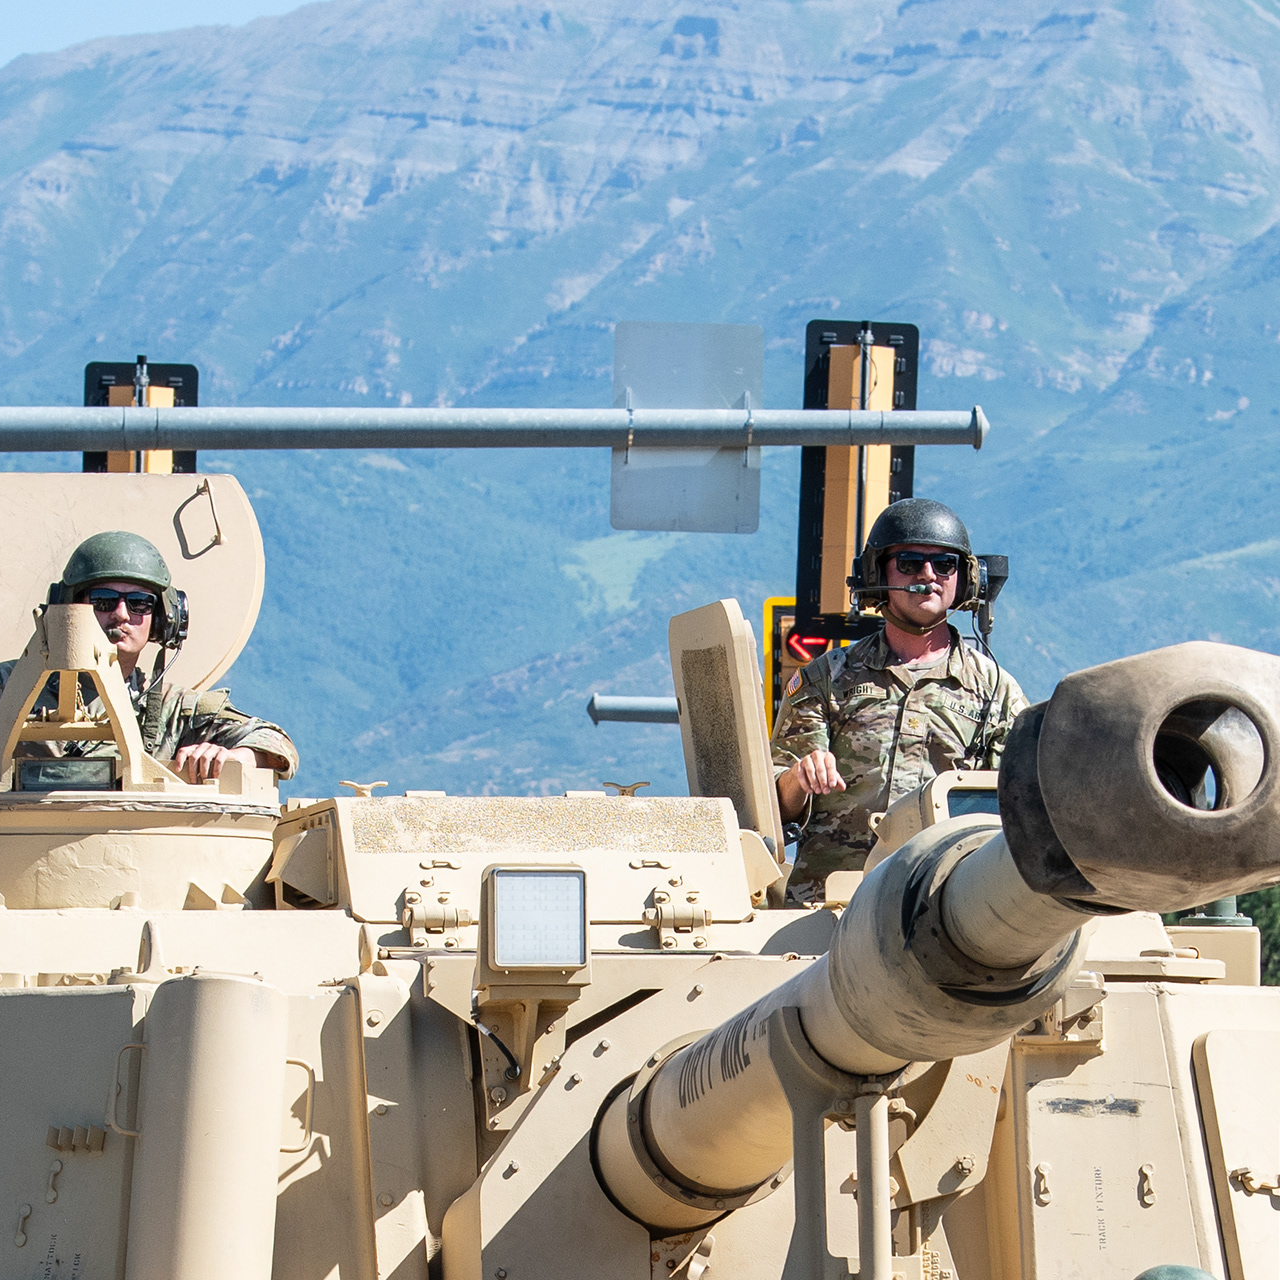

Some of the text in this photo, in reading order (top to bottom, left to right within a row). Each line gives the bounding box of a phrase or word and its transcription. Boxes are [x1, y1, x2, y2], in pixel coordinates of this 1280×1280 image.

[949, 701, 994, 723] U.S. ARY
[679, 1007, 757, 1109] DIRTY MIKE
[1093, 1166, 1107, 1251] TRACK FIXTURE
